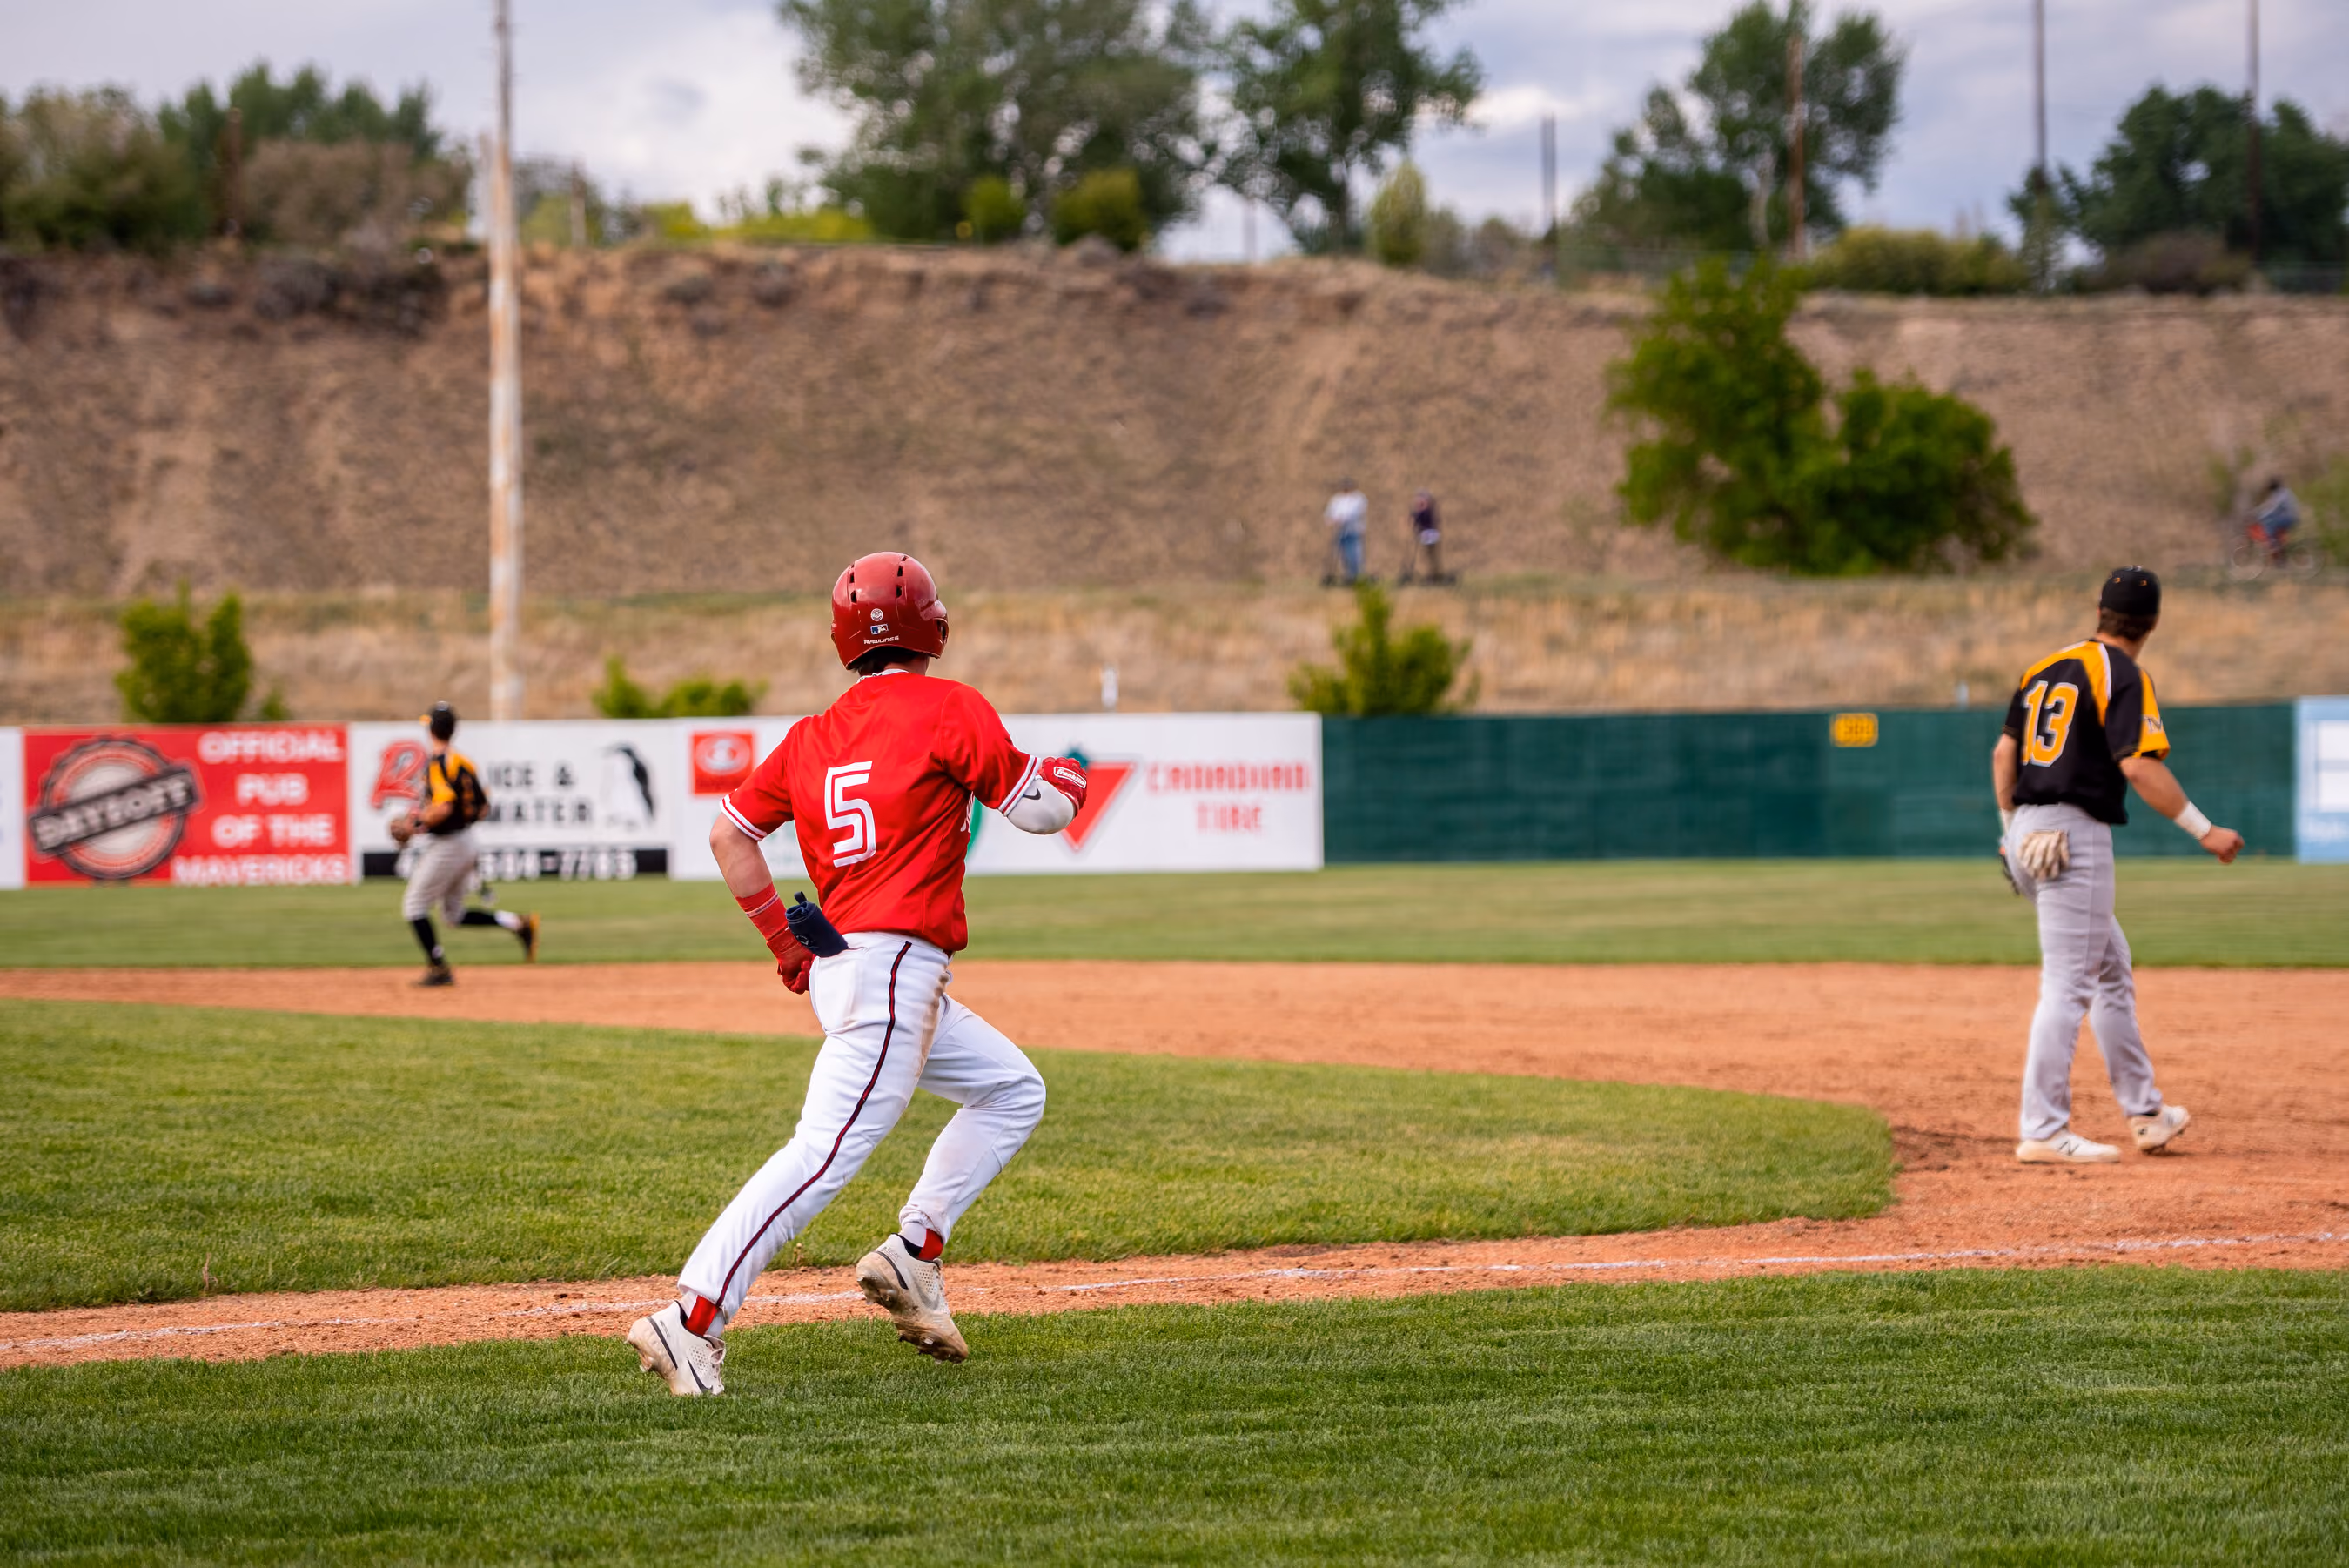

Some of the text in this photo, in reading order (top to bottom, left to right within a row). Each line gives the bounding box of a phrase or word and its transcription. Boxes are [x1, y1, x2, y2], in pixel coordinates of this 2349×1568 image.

[2023, 680, 2079, 767] 13
[198, 731, 345, 763] OFFICIAL
[237, 772, 310, 807] PUB
[554, 760, 579, 787] &
[1145, 762, 1311, 793] CANADIAN
[823, 761, 876, 868] 5
[1195, 801, 1262, 831] TIRE
[211, 814, 336, 848] OF THE
[172, 854, 351, 886] MAVERICKS
